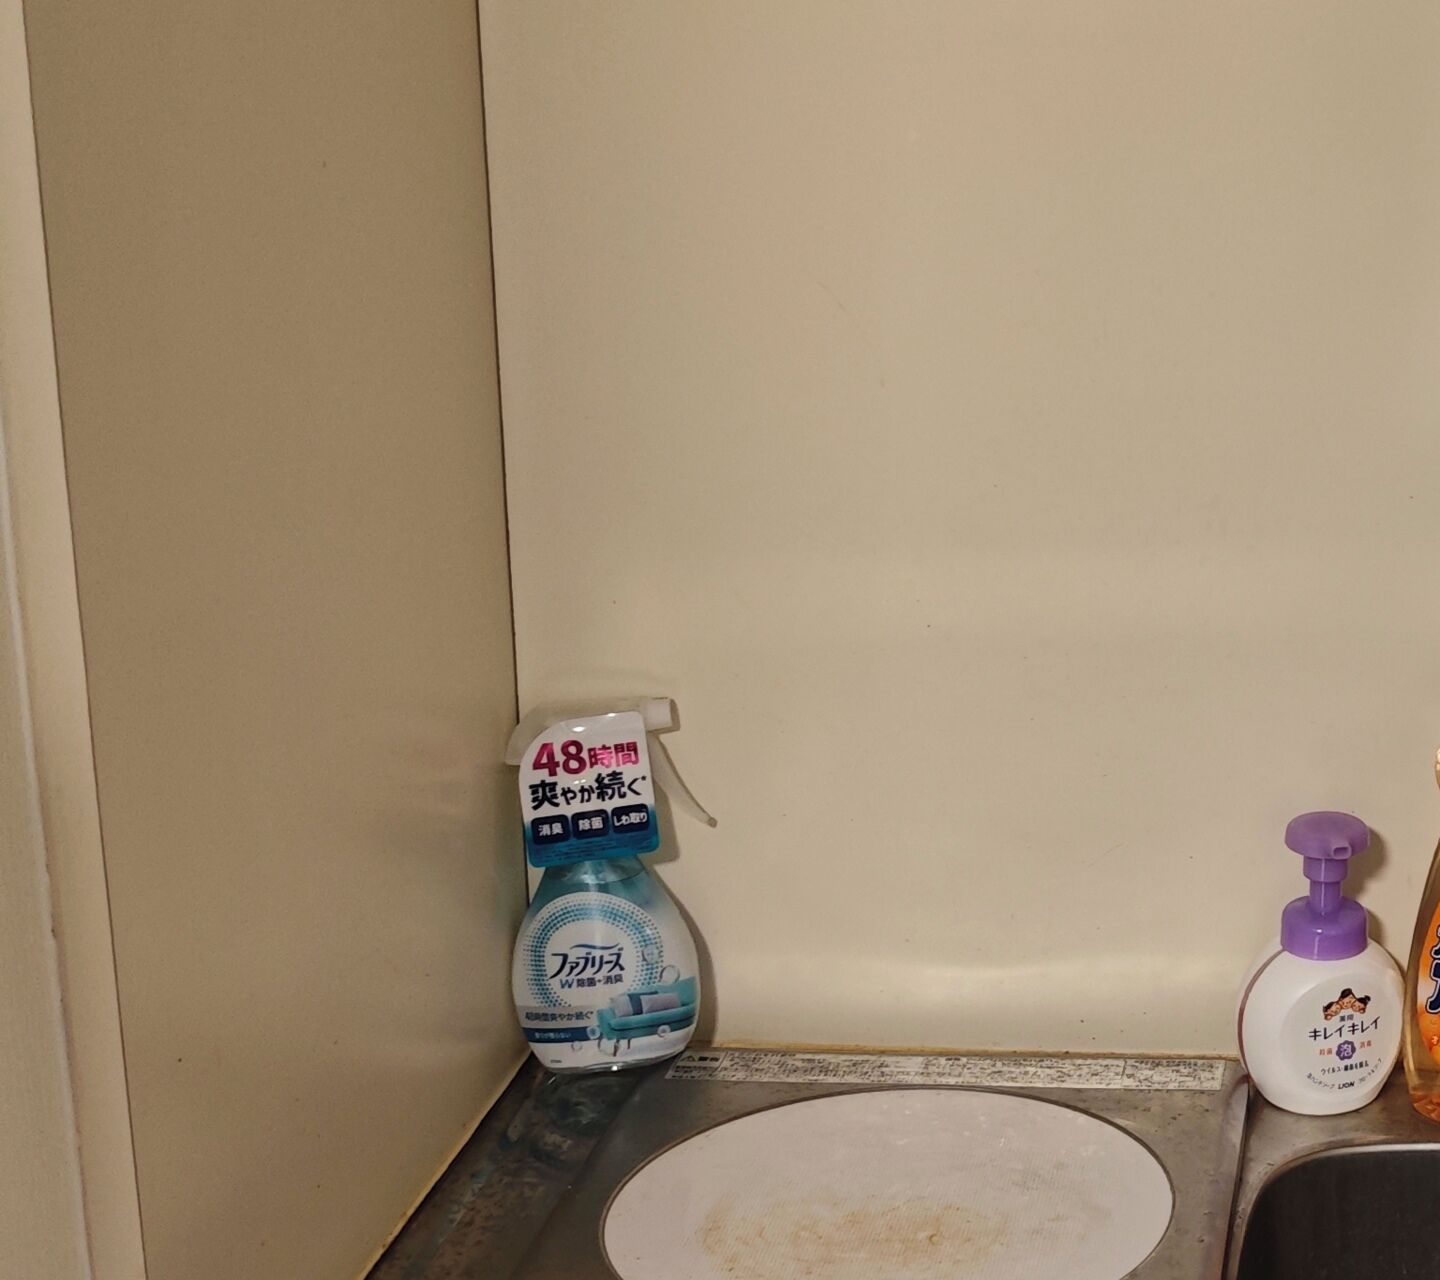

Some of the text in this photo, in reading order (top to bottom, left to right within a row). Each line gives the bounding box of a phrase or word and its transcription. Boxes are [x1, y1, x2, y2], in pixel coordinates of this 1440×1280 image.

[532, 739, 640, 777] 48時間
[528, 770, 643, 811] 爽やか続く
[538, 822, 564, 836] 消臭
[578, 817, 603, 831] 除菌
[613, 812, 648, 827] しわ取り
[549, 947, 625, 980] ファブリーズ
[1308, 1016, 1381, 1041] キレイキレイ
[1338, 1081, 1355, 1090] LION
